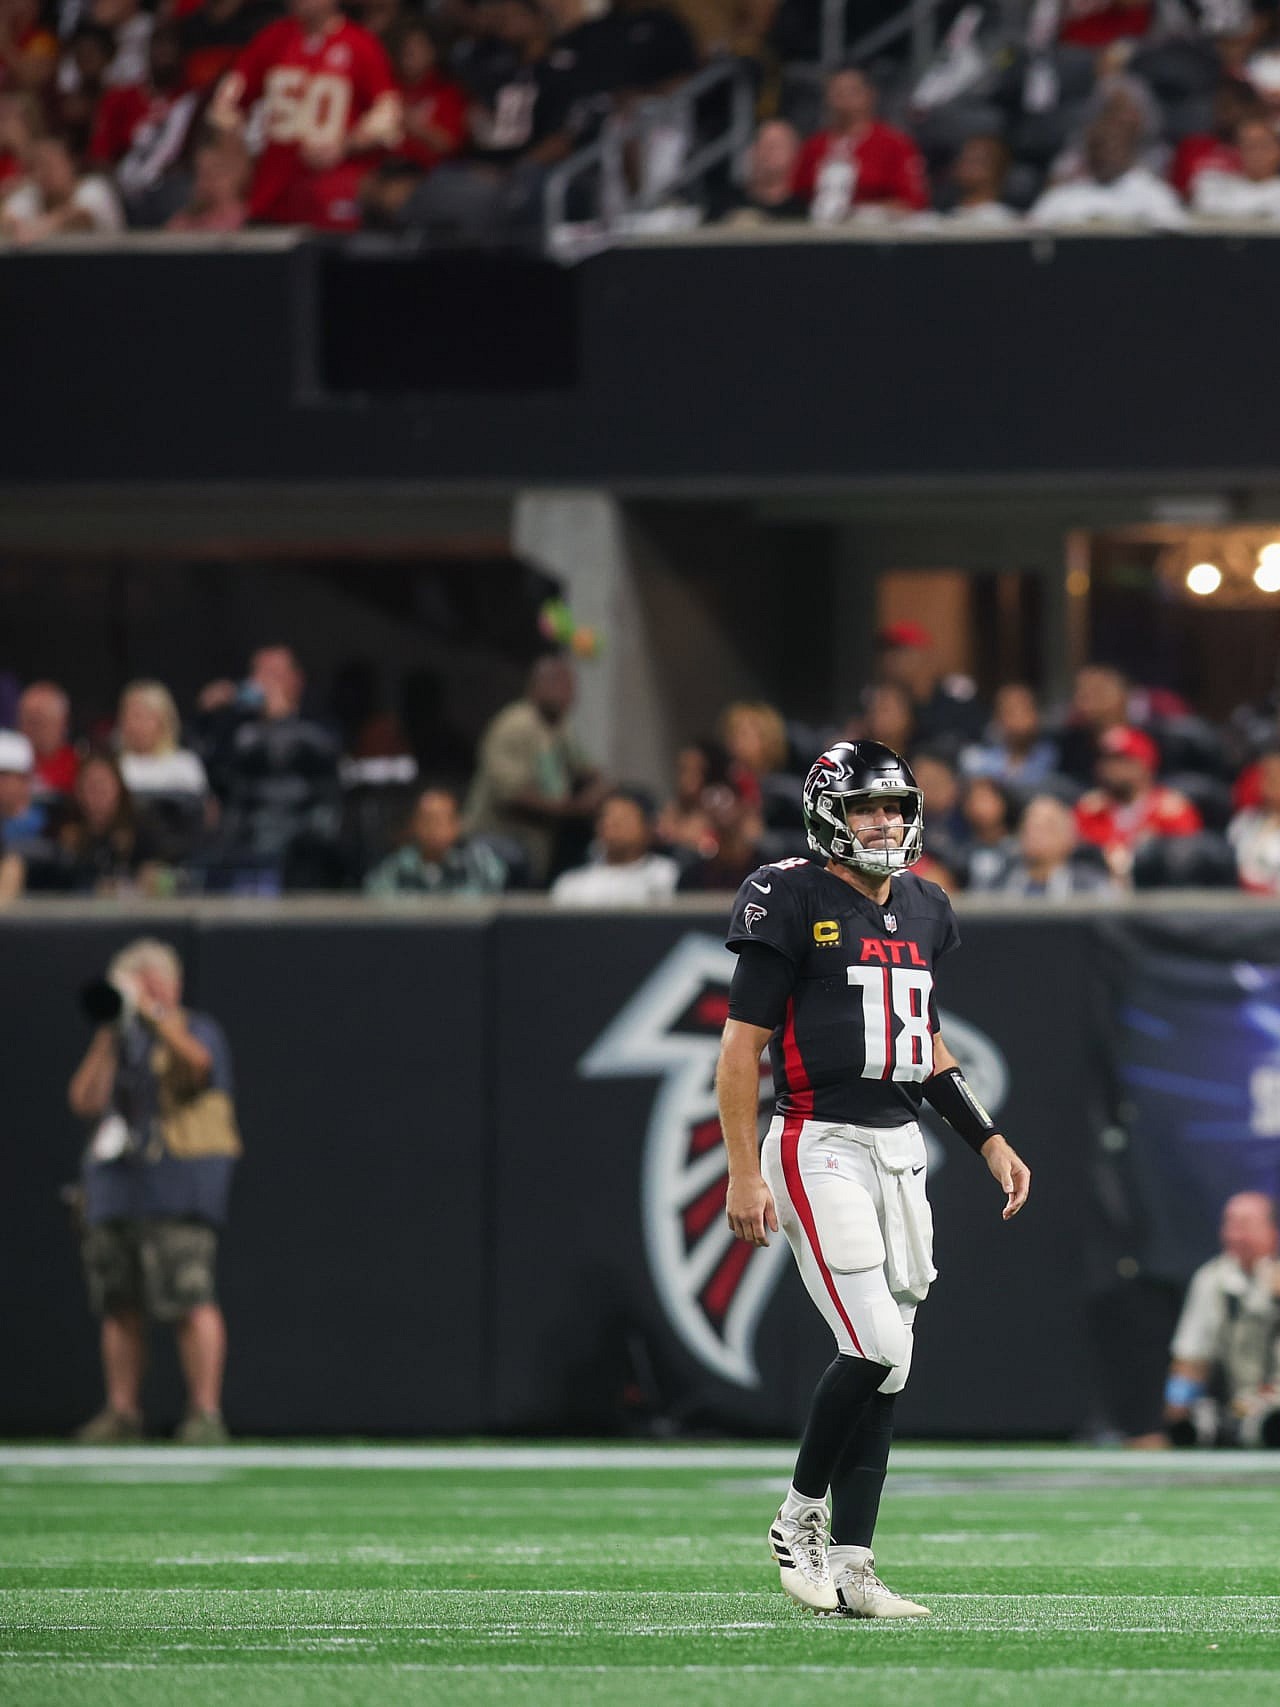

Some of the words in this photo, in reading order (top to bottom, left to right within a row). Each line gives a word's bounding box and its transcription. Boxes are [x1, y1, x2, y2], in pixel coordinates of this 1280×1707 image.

[264, 66, 353, 154] 50
[881, 780, 900, 788] ATL
[813, 920, 841, 942] C
[859, 937, 927, 967] ATL
[846, 965, 936, 1084] 18
